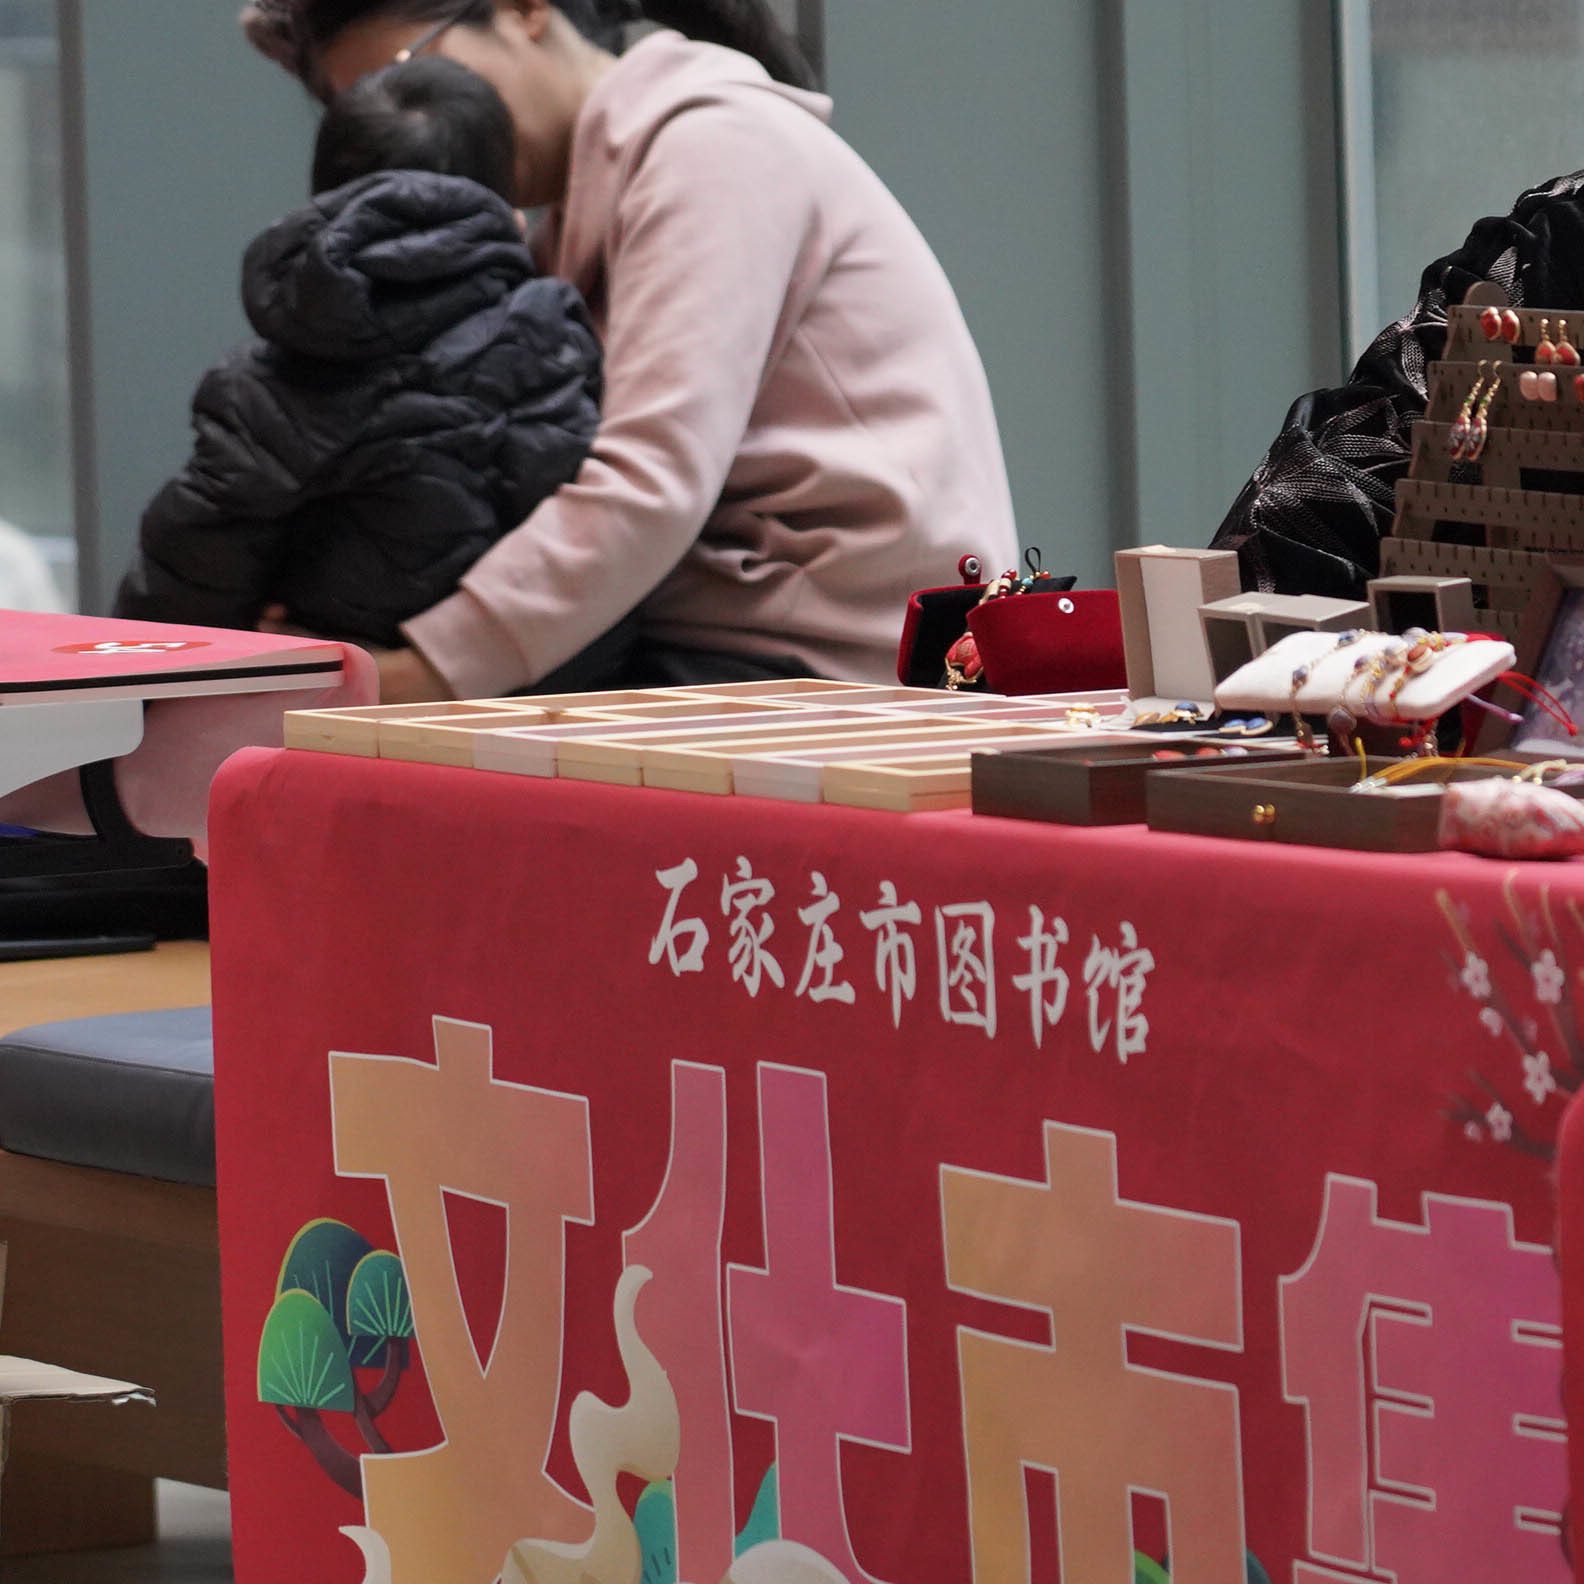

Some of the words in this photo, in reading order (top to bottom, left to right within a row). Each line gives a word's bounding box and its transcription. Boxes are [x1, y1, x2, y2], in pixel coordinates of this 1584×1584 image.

[649, 855, 1155, 1064] 石家庄市图书馆
